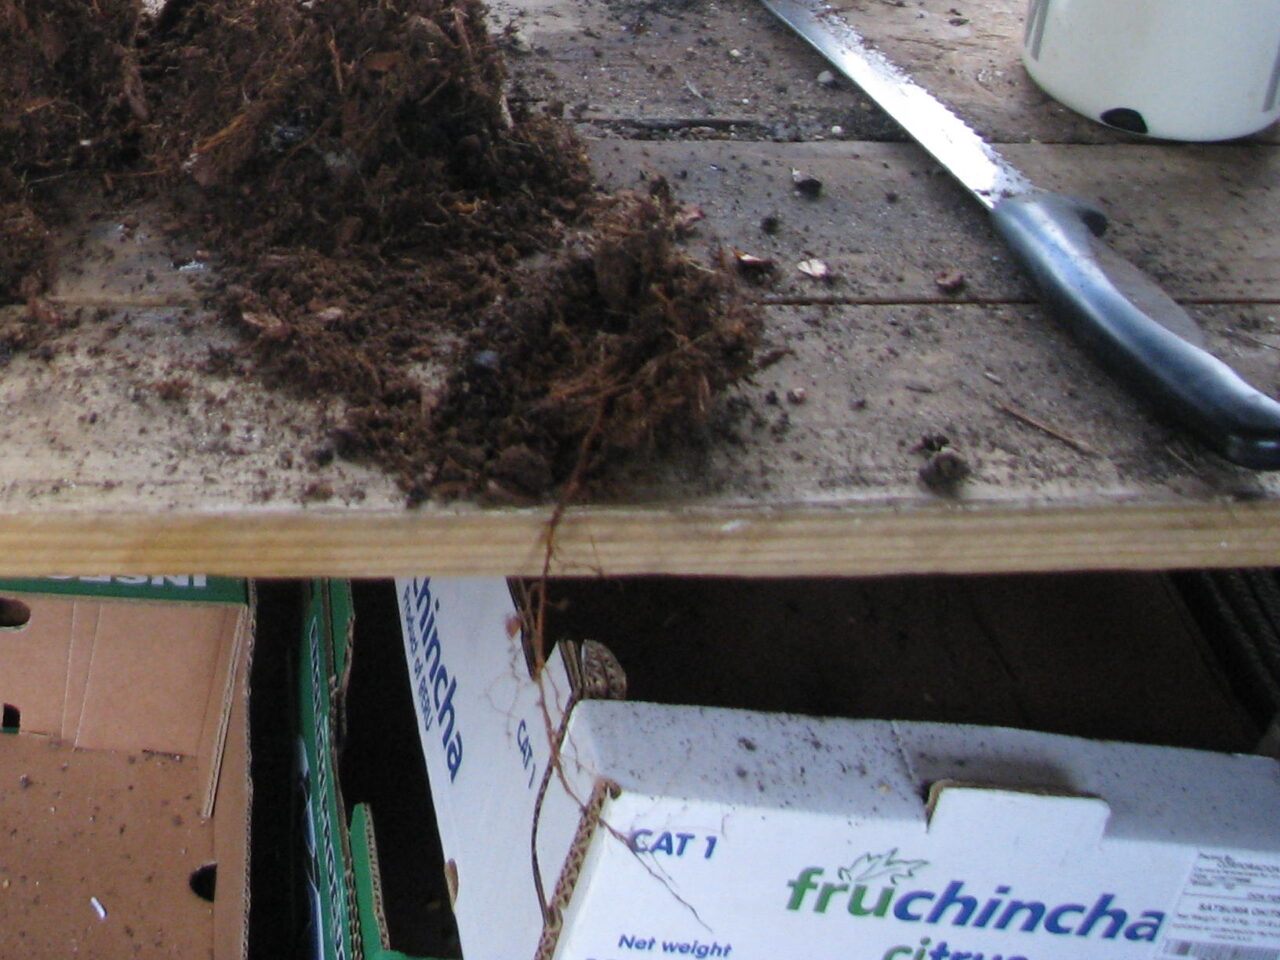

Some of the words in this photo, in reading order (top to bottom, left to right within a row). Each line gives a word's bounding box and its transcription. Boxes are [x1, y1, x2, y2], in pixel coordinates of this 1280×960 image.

[517, 719, 532, 770] CAT
[631, 828, 694, 856] CAT
[704, 836, 718, 859] 1
[786, 866, 1166, 943] fruchincha
[618, 933, 656, 951] Net
[662, 939, 732, 959] weight
